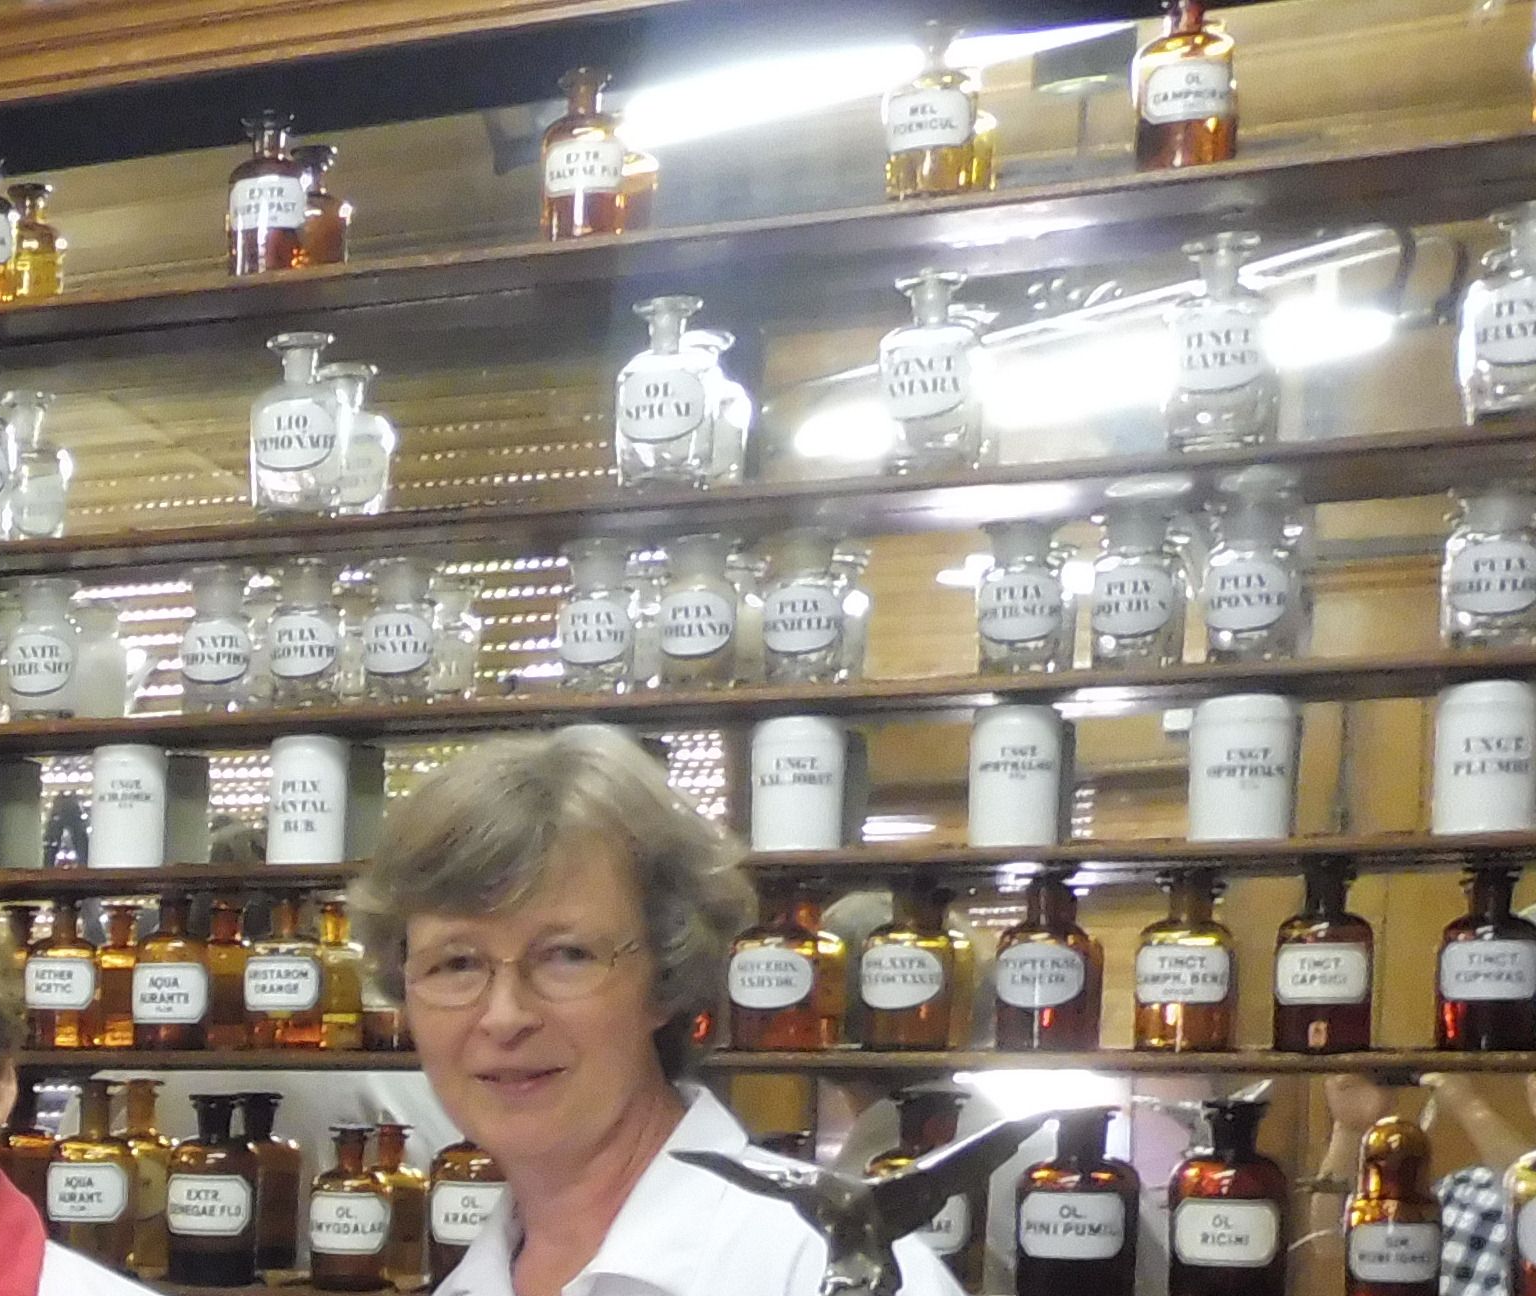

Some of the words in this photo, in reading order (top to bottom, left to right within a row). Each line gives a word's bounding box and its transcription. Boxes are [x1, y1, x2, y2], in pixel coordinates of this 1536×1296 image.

[276, 415, 309, 434] LIQ
[148, 976, 180, 991] AQUA
[63, 1176, 95, 1190] AQUA
